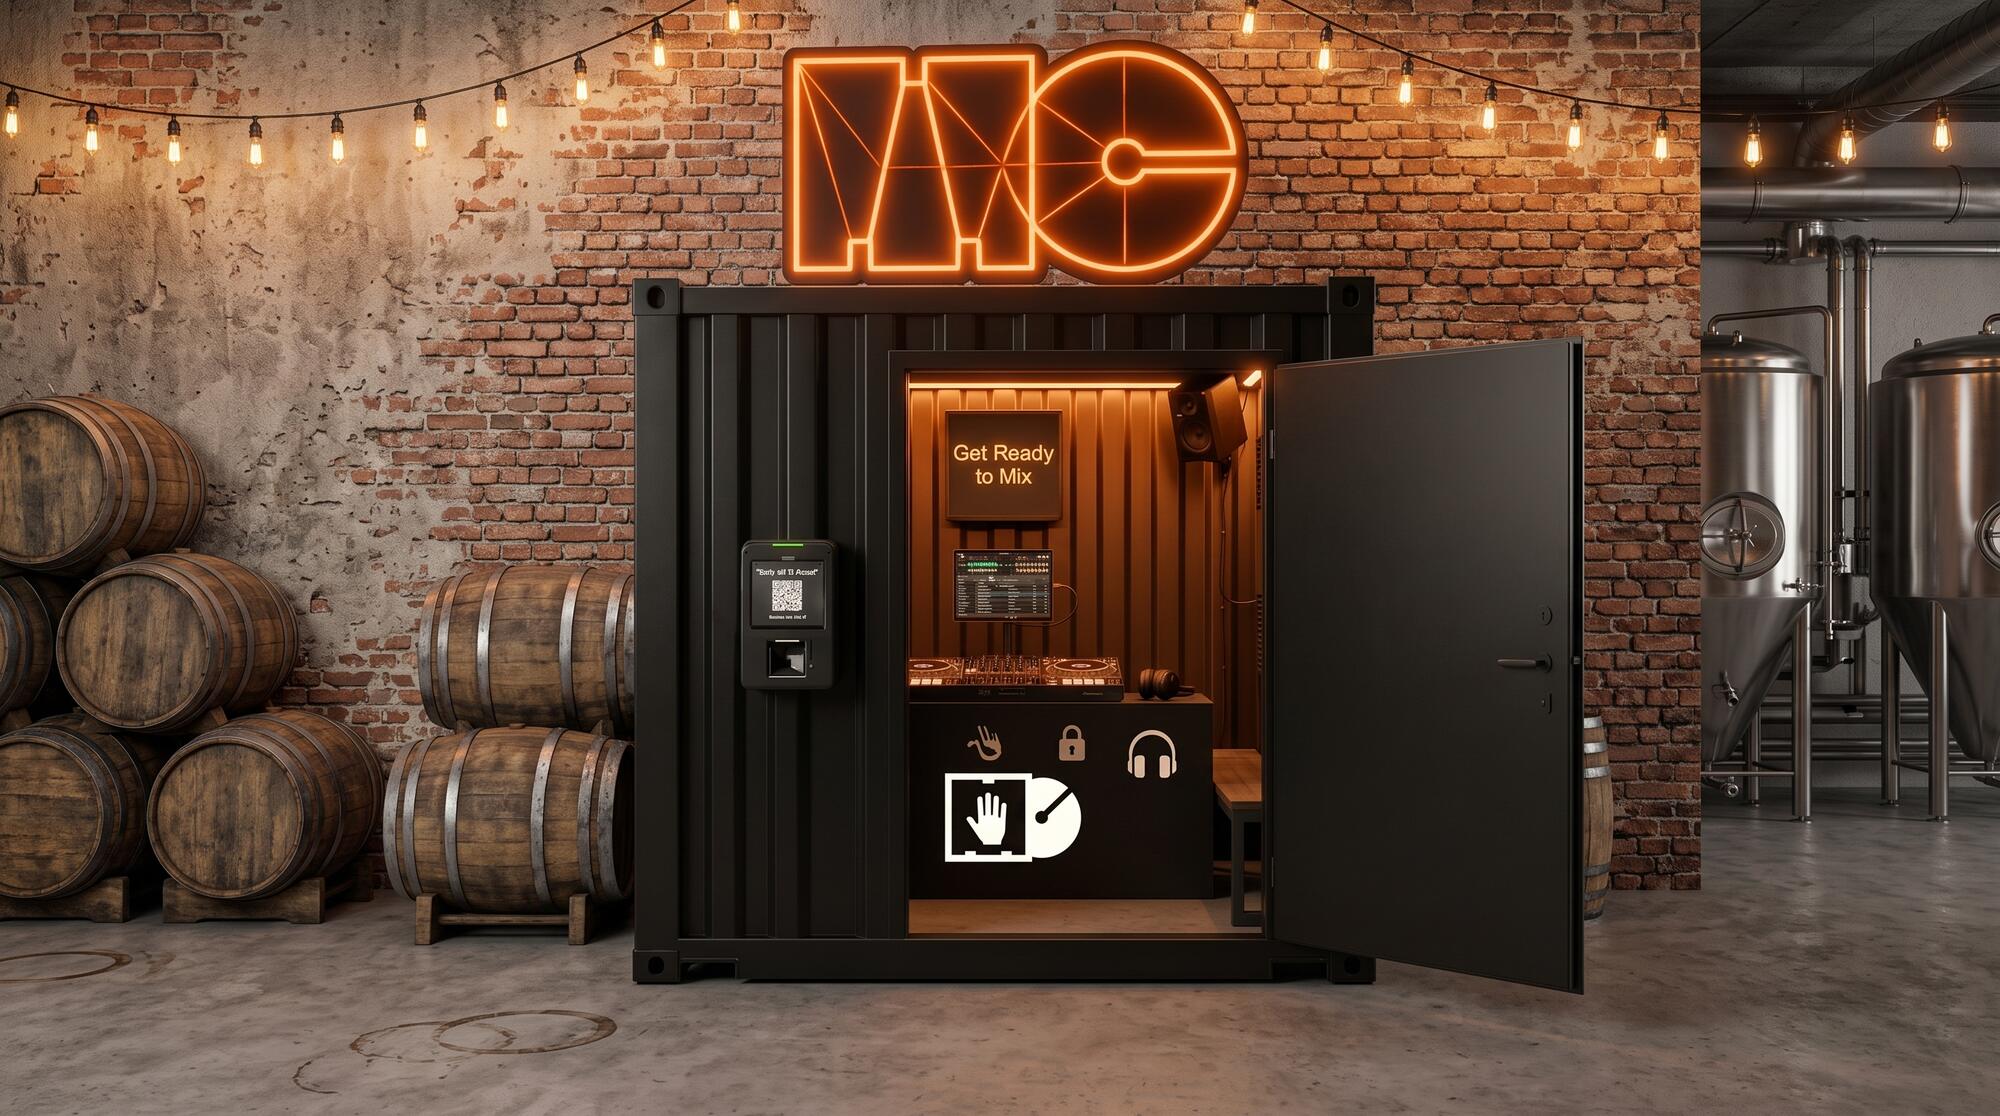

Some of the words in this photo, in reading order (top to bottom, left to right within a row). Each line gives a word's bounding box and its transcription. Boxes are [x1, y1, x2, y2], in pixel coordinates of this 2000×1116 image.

[953, 444, 988, 461] Get
[994, 444, 1055, 465] Ready
[976, 468, 993, 485] to
[999, 468, 1032, 485] Mix
